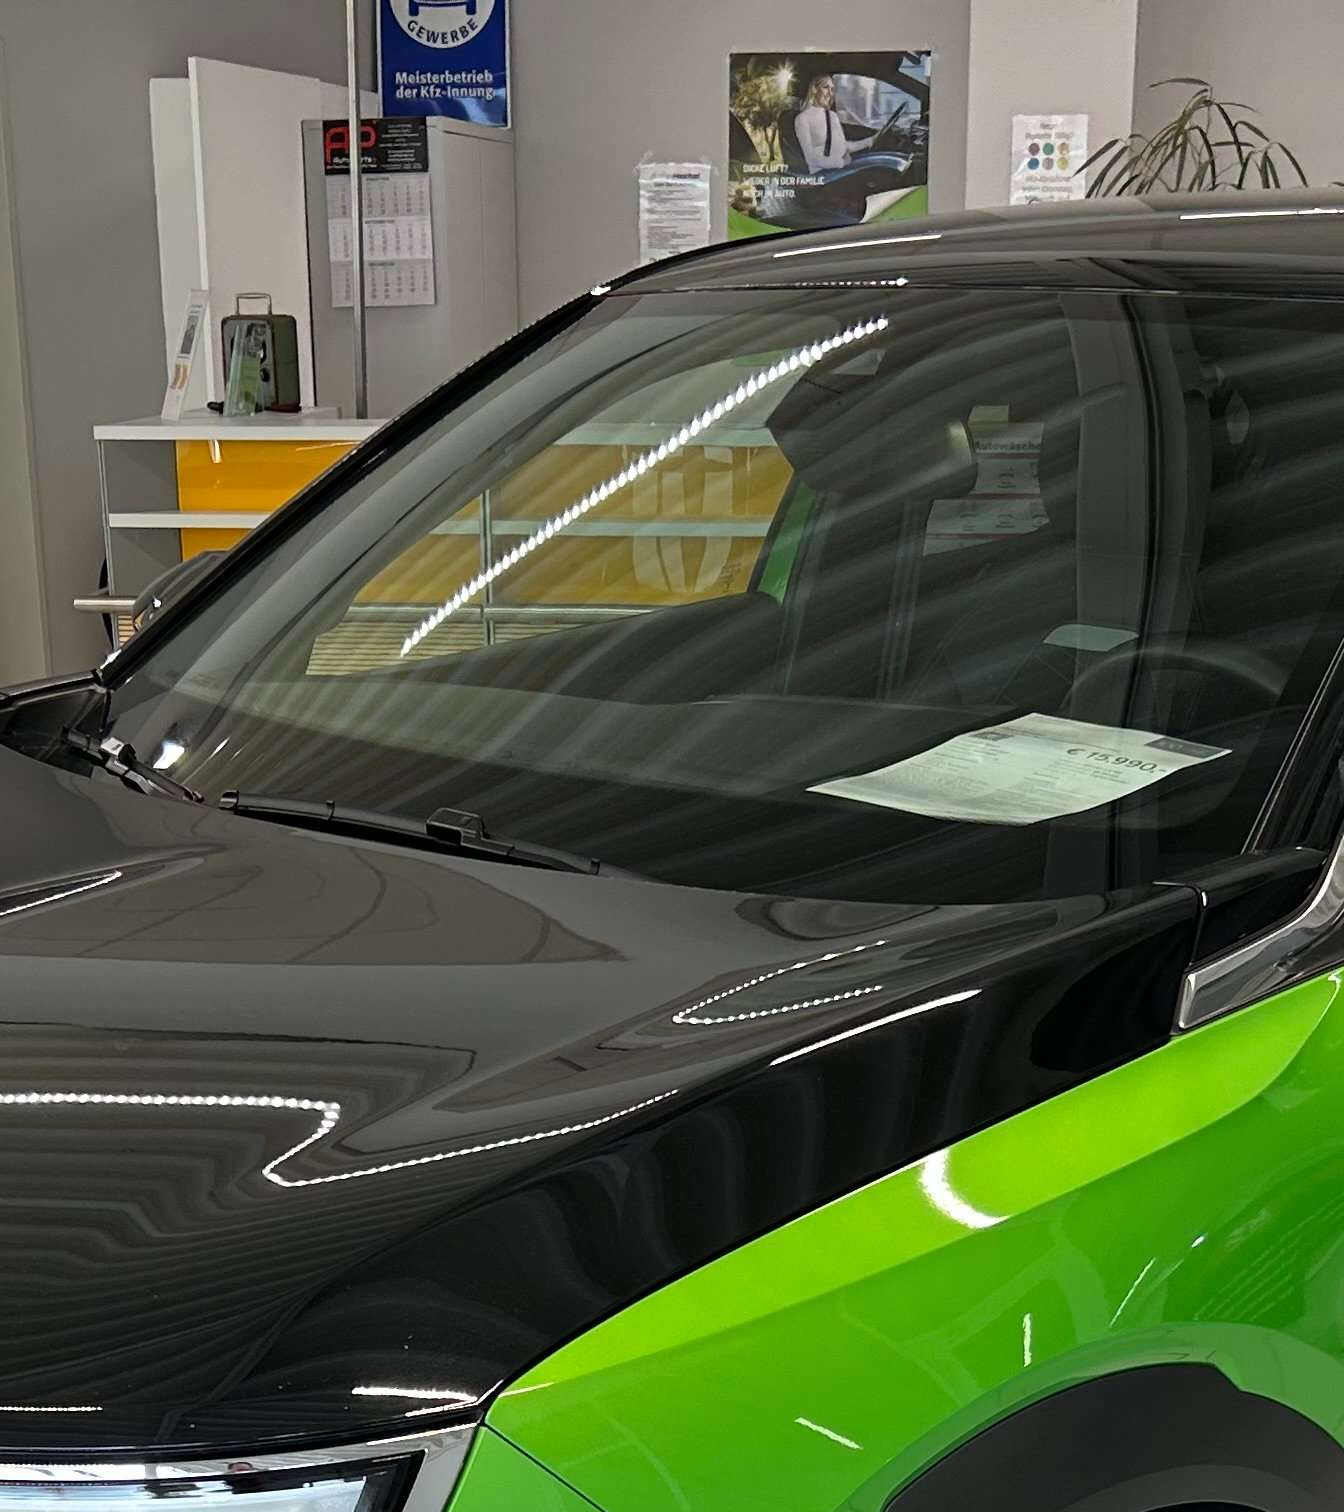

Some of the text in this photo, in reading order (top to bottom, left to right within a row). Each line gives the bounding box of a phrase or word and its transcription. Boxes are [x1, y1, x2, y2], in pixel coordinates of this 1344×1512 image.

[407, 18, 478, 44] GEWERBE
[395, 69, 493, 85] Meisterbetrieb
[396, 85, 494, 100] der Kfz-Innung
[780, 176, 796, 186] DER
[797, 176, 825, 186] FAMILIE
